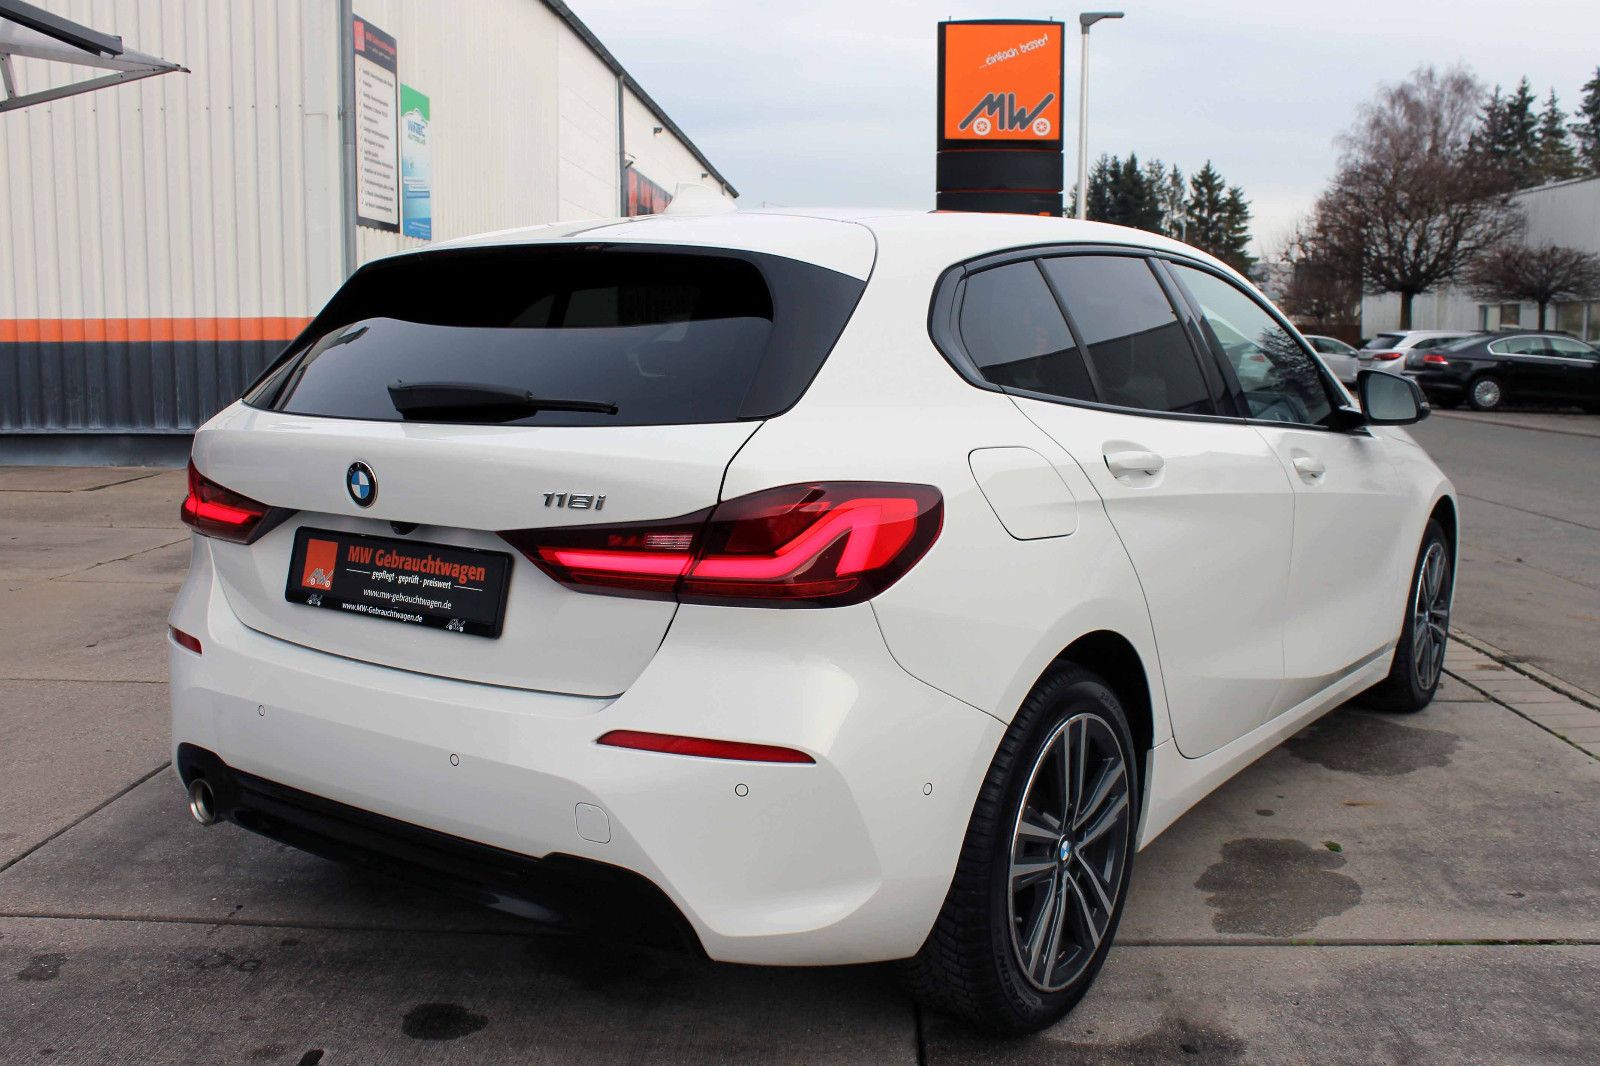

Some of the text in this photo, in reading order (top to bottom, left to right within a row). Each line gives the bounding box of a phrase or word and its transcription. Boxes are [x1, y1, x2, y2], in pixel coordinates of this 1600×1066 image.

[958, 91, 1056, 134] MW
[543, 492, 607, 510] 118i
[348, 546, 486, 584] MW Gebrauchtwagen
[371, 570, 452, 590] gepflegt geprüft preiswert
[363, 588, 452, 610] www.mw-gebrauchtwagen.de
[342, 601, 423, 623] www.MW-Gebrauchtwagen.de
